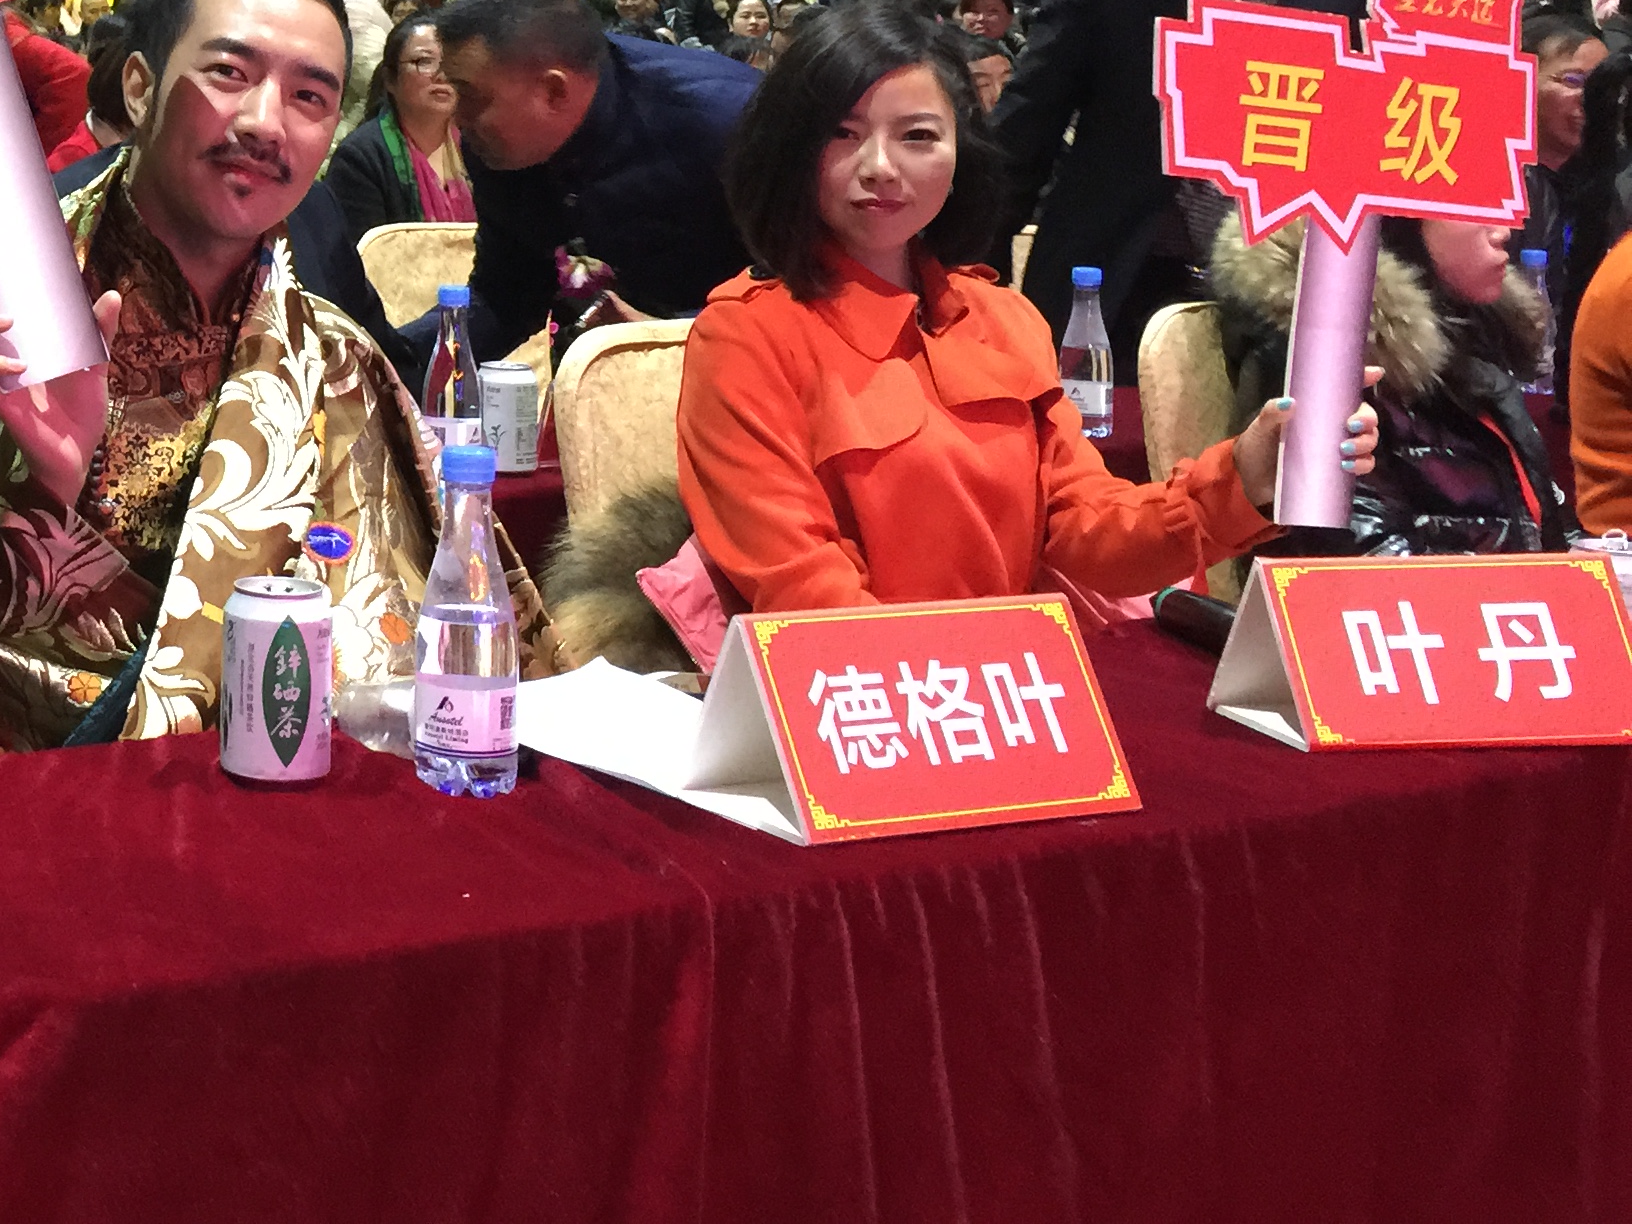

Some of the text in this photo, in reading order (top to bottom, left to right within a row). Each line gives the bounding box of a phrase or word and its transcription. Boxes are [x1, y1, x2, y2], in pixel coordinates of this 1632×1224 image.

[1239, 60, 1462, 186] 晋级
[807, 652, 1069, 774] 德格叶
[1343, 600, 1575, 705] 叶丹
